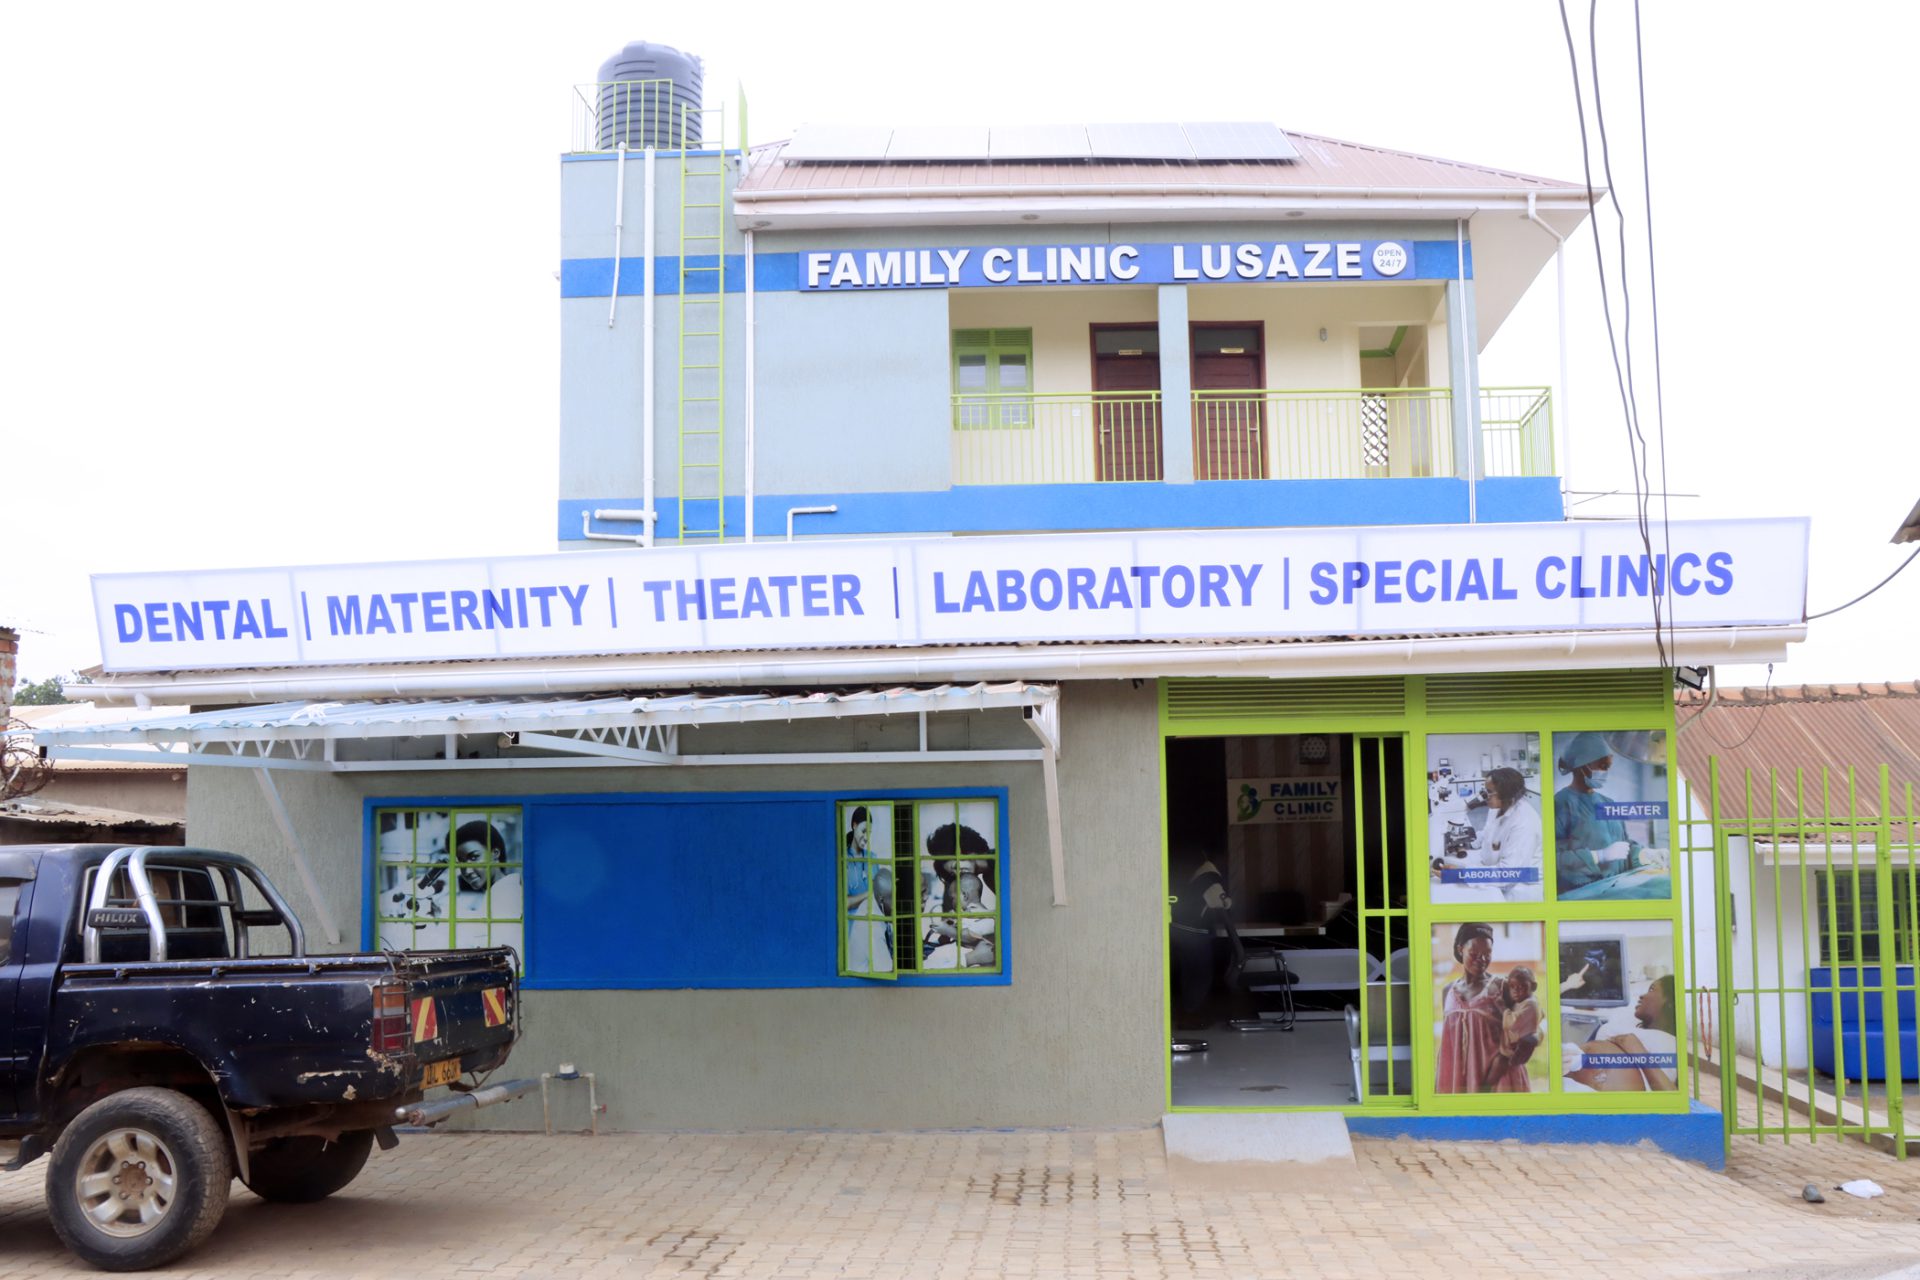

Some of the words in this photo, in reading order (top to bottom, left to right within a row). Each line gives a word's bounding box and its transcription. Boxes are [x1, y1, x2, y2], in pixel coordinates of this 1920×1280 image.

[808, 249, 970, 287] FAMILY
[982, 245, 1140, 283] CLINIC
[1173, 243, 1363, 280] LUSAZE
[1379, 258, 1402, 268] 24/7
[113, 598, 288, 643] DENTAL
[327, 584, 589, 636] MATERNITY
[643, 574, 864, 622] THEATER
[934, 563, 1263, 614] LABORATORY
[1309, 557, 1518, 604] SPECIAL
[1535, 551, 1734, 600] CLINICS
[1270, 782, 1338, 797] FAMILY
[1274, 801, 1333, 815] CLINIC
[1604, 804, 1661, 816] THEATER
[1458, 870, 1521, 879] LABORATORY
[94, 913, 137, 923] HILUX
[1589, 1056, 1647, 1064] ULTRASOUND
[1648, 1055, 1673, 1064] SCAN
